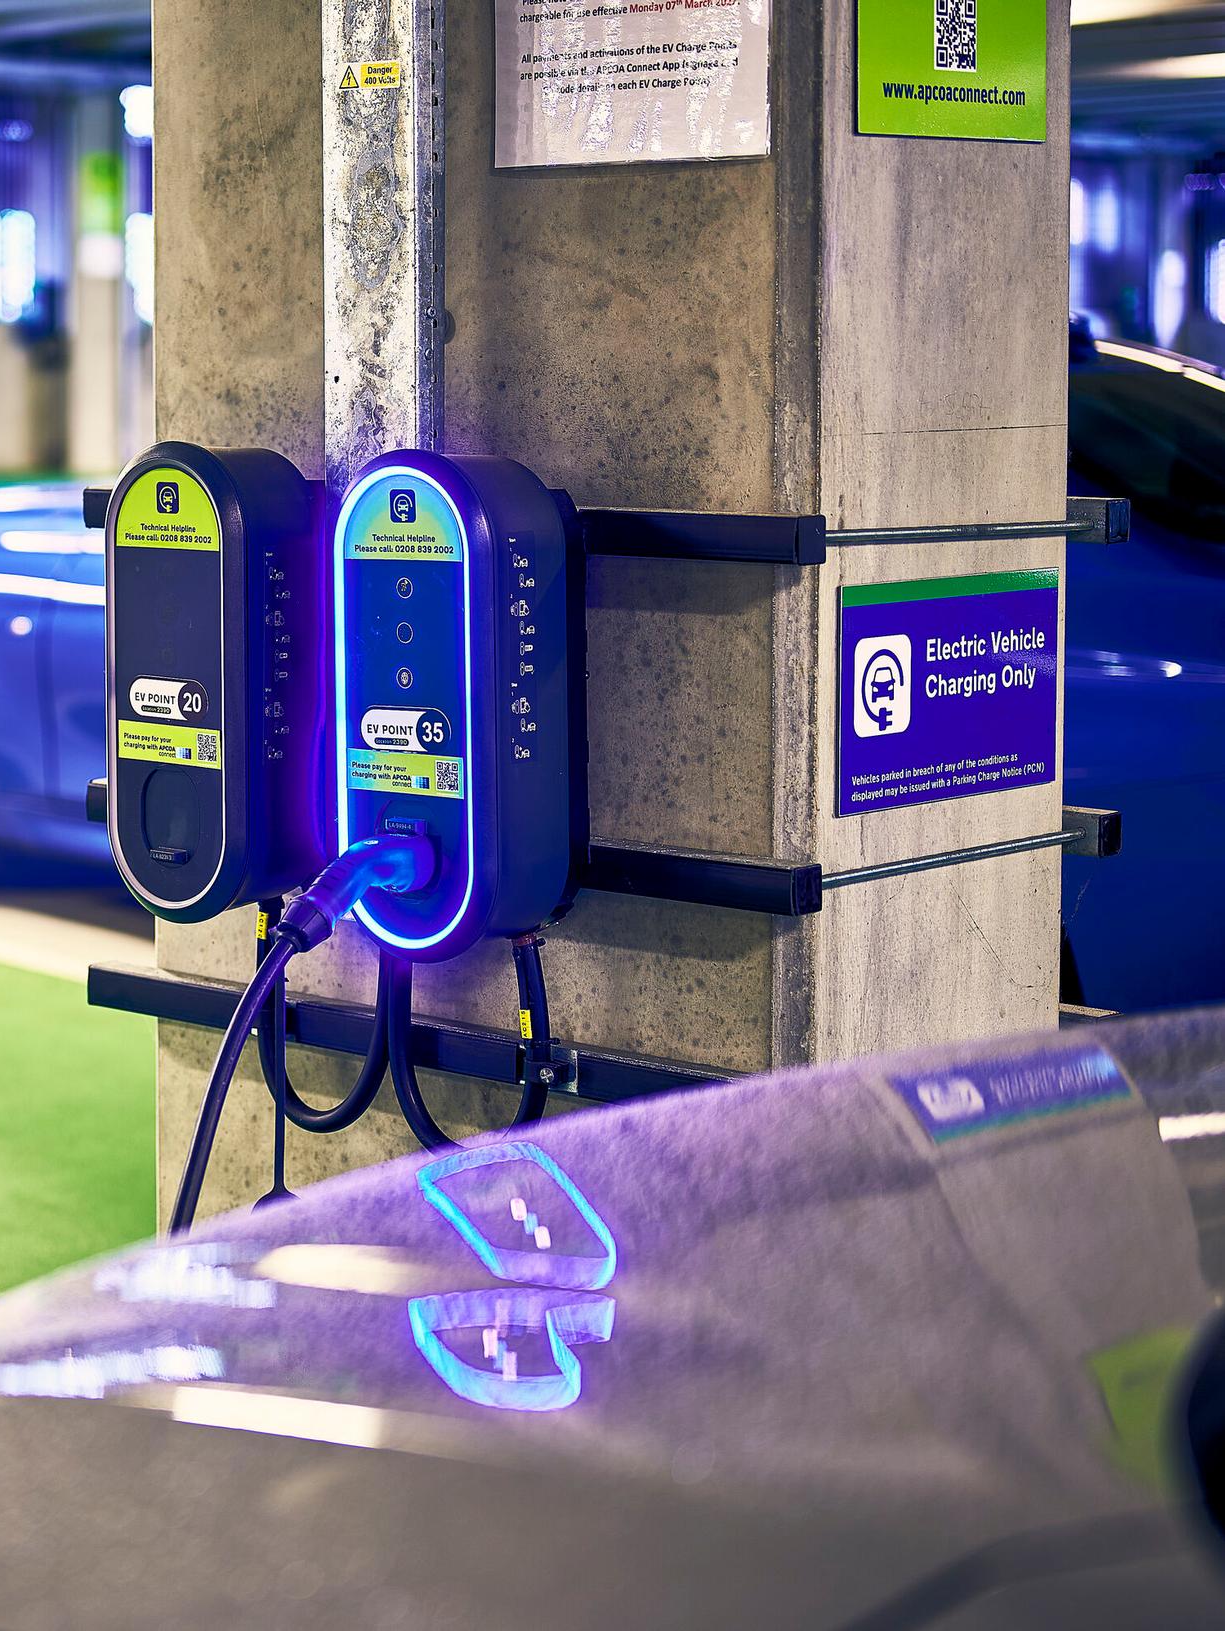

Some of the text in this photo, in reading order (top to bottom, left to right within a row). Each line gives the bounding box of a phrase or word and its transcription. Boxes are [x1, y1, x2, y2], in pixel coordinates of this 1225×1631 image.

[563, 9, 574, 18] for
[592, 6, 628, 16] effective
[629, 4, 664, 13] Monday
[684, 0, 713, 9] March
[521, 54, 531, 64] All
[636, 45, 645, 55] of
[646, 45, 660, 54] the
[662, 44, 673, 53] EV
[676, 42, 706, 53] Charge
[368, 66, 392, 75] Danger
[520, 71, 532, 80] are
[627, 62, 660, 73] Connect
[662, 61, 680, 72] App
[618, 80, 636, 90] each
[639, 79, 650, 89] EV
[652, 78, 681, 89] Charge
[883, 82, 1026, 106] www.apcoaconnect.com
[140, 523, 196, 533] Technical Helpline
[372, 534, 435, 543] Technical Helpline
[926, 627, 1045, 662] Electric Vehicle
[925, 663, 1036, 698] Charging Only
[135, 692, 201, 712] EV POINT 20
[367, 721, 444, 743] EV POINT 35
[124, 742, 145, 750] charging
[352, 762, 370, 770] Please
[352, 770, 376, 780] charging
[852, 754, 1018, 786] Vehicles parked in breach of any of the conditions as
[851, 788, 884, 802] displayed
[885, 787, 898, 797] may
[899, 784, 908, 794] be
[909, 780, 930, 792] issued
[932, 778, 945, 789] with
[952, 774, 976, 785] Parking
[978, 772, 1000, 781] Charge
[1002, 767, 1022, 777] Notice
[1024, 762, 1045, 776] (PCN)
